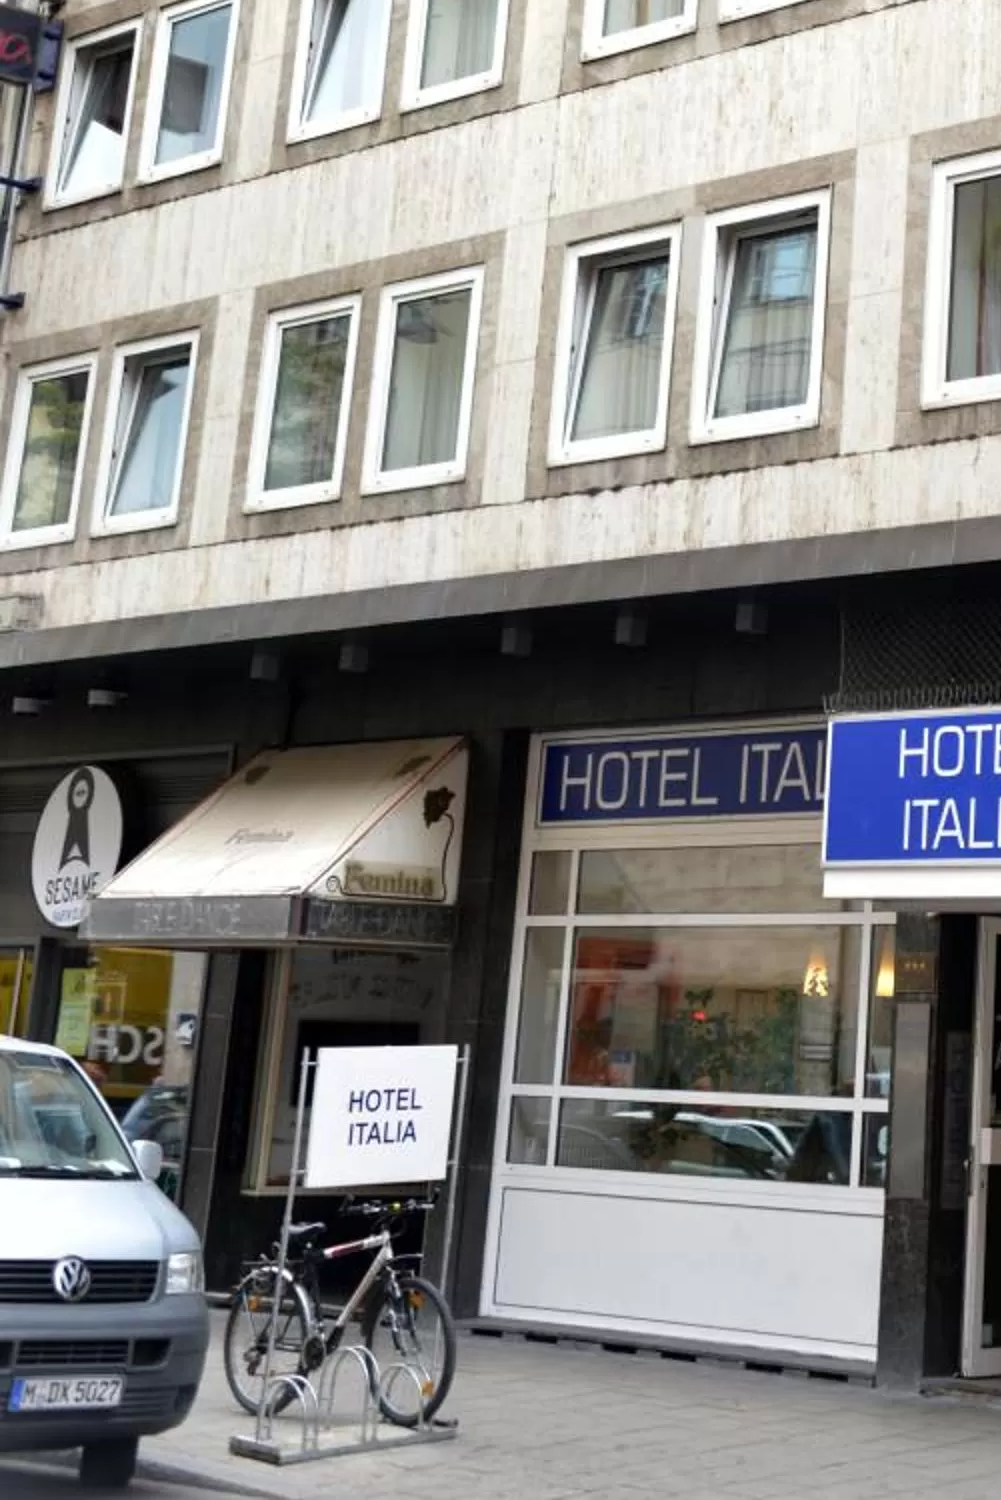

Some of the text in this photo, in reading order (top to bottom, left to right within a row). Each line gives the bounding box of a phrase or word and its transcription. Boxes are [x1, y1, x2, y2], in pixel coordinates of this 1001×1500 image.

[559, 747, 719, 811] HOTEL
[348, 1088, 423, 1113] HOTEL
[347, 1119, 417, 1146] ITALIA
